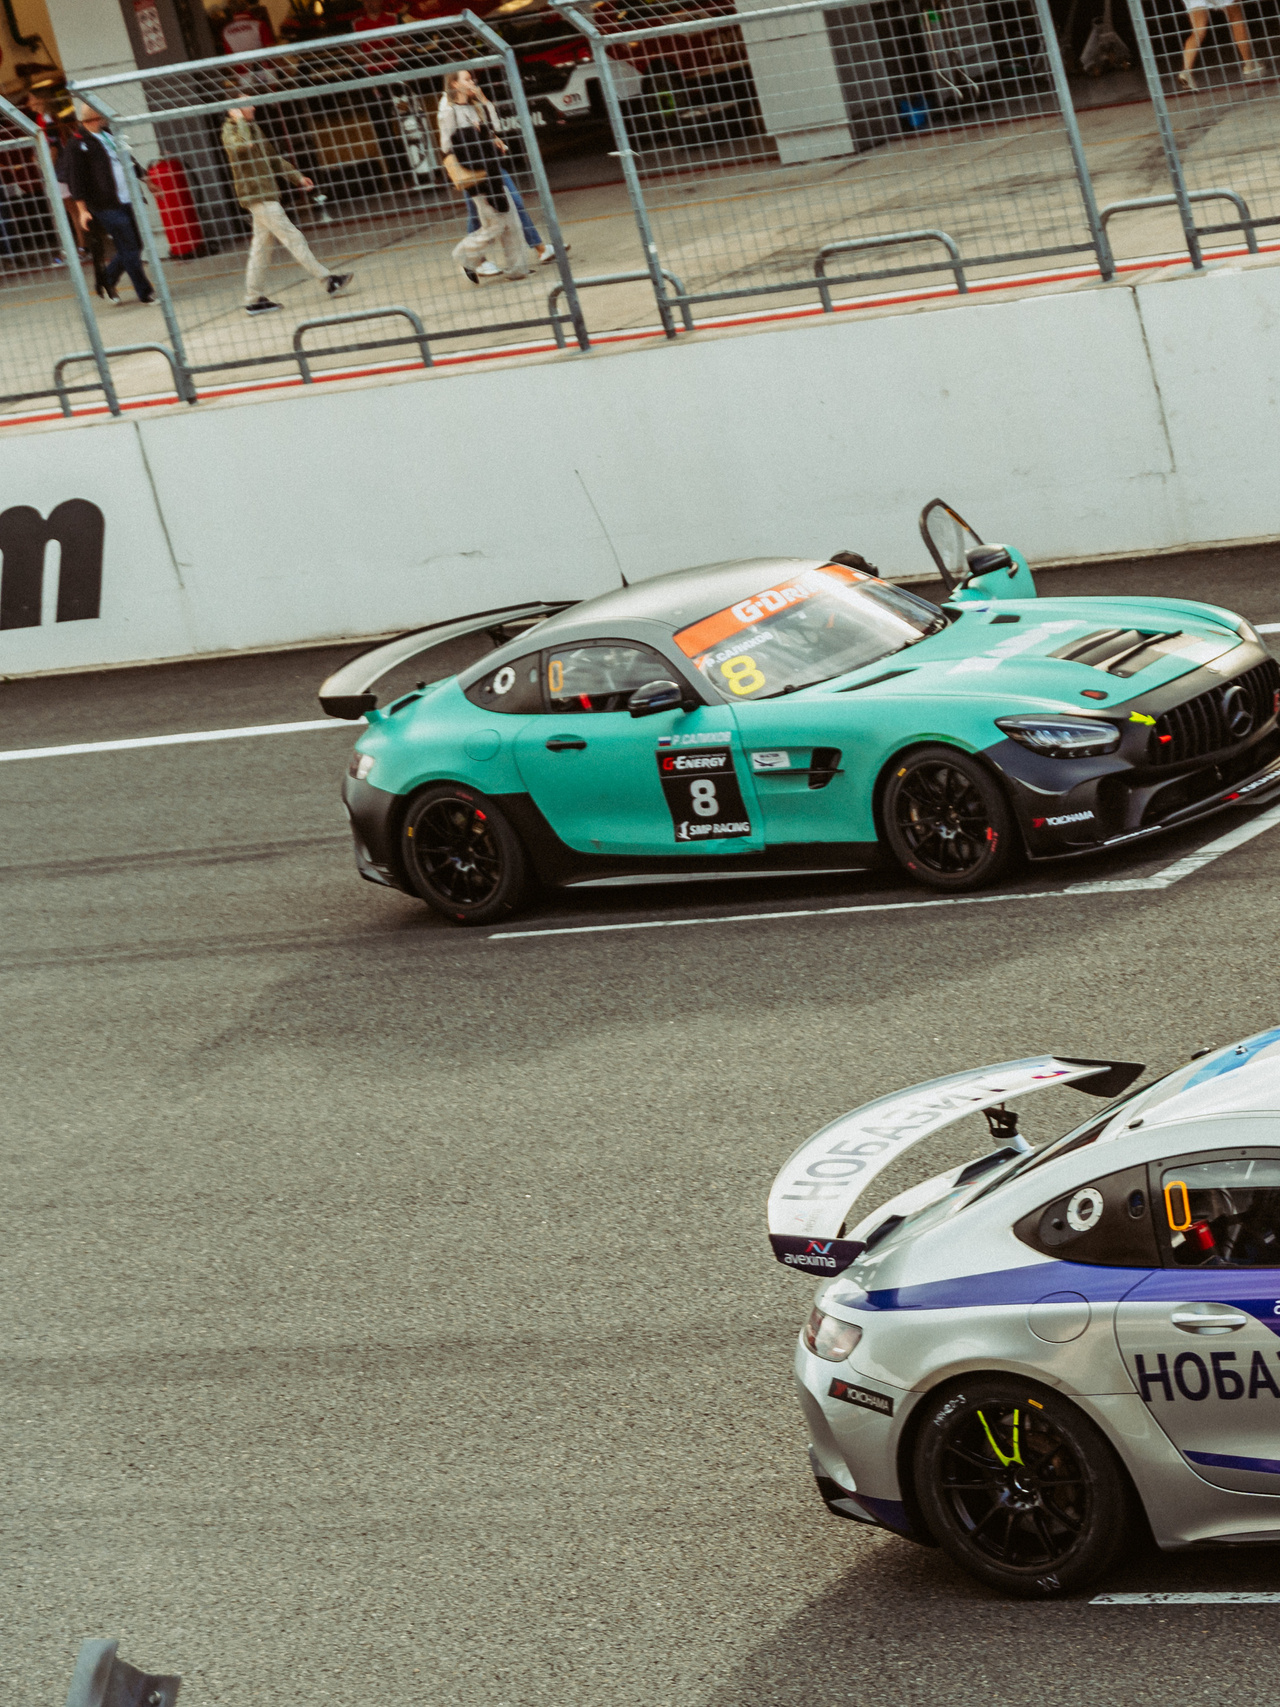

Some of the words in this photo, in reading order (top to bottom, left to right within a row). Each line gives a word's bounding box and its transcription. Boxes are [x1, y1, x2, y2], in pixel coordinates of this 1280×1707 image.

[721, 655, 766, 695] 8
[690, 779, 720, 817] 8
[689, 825, 713, 836] SMP
[713, 821, 750, 834] RACING
[784, 1253, 836, 1268] avexima
